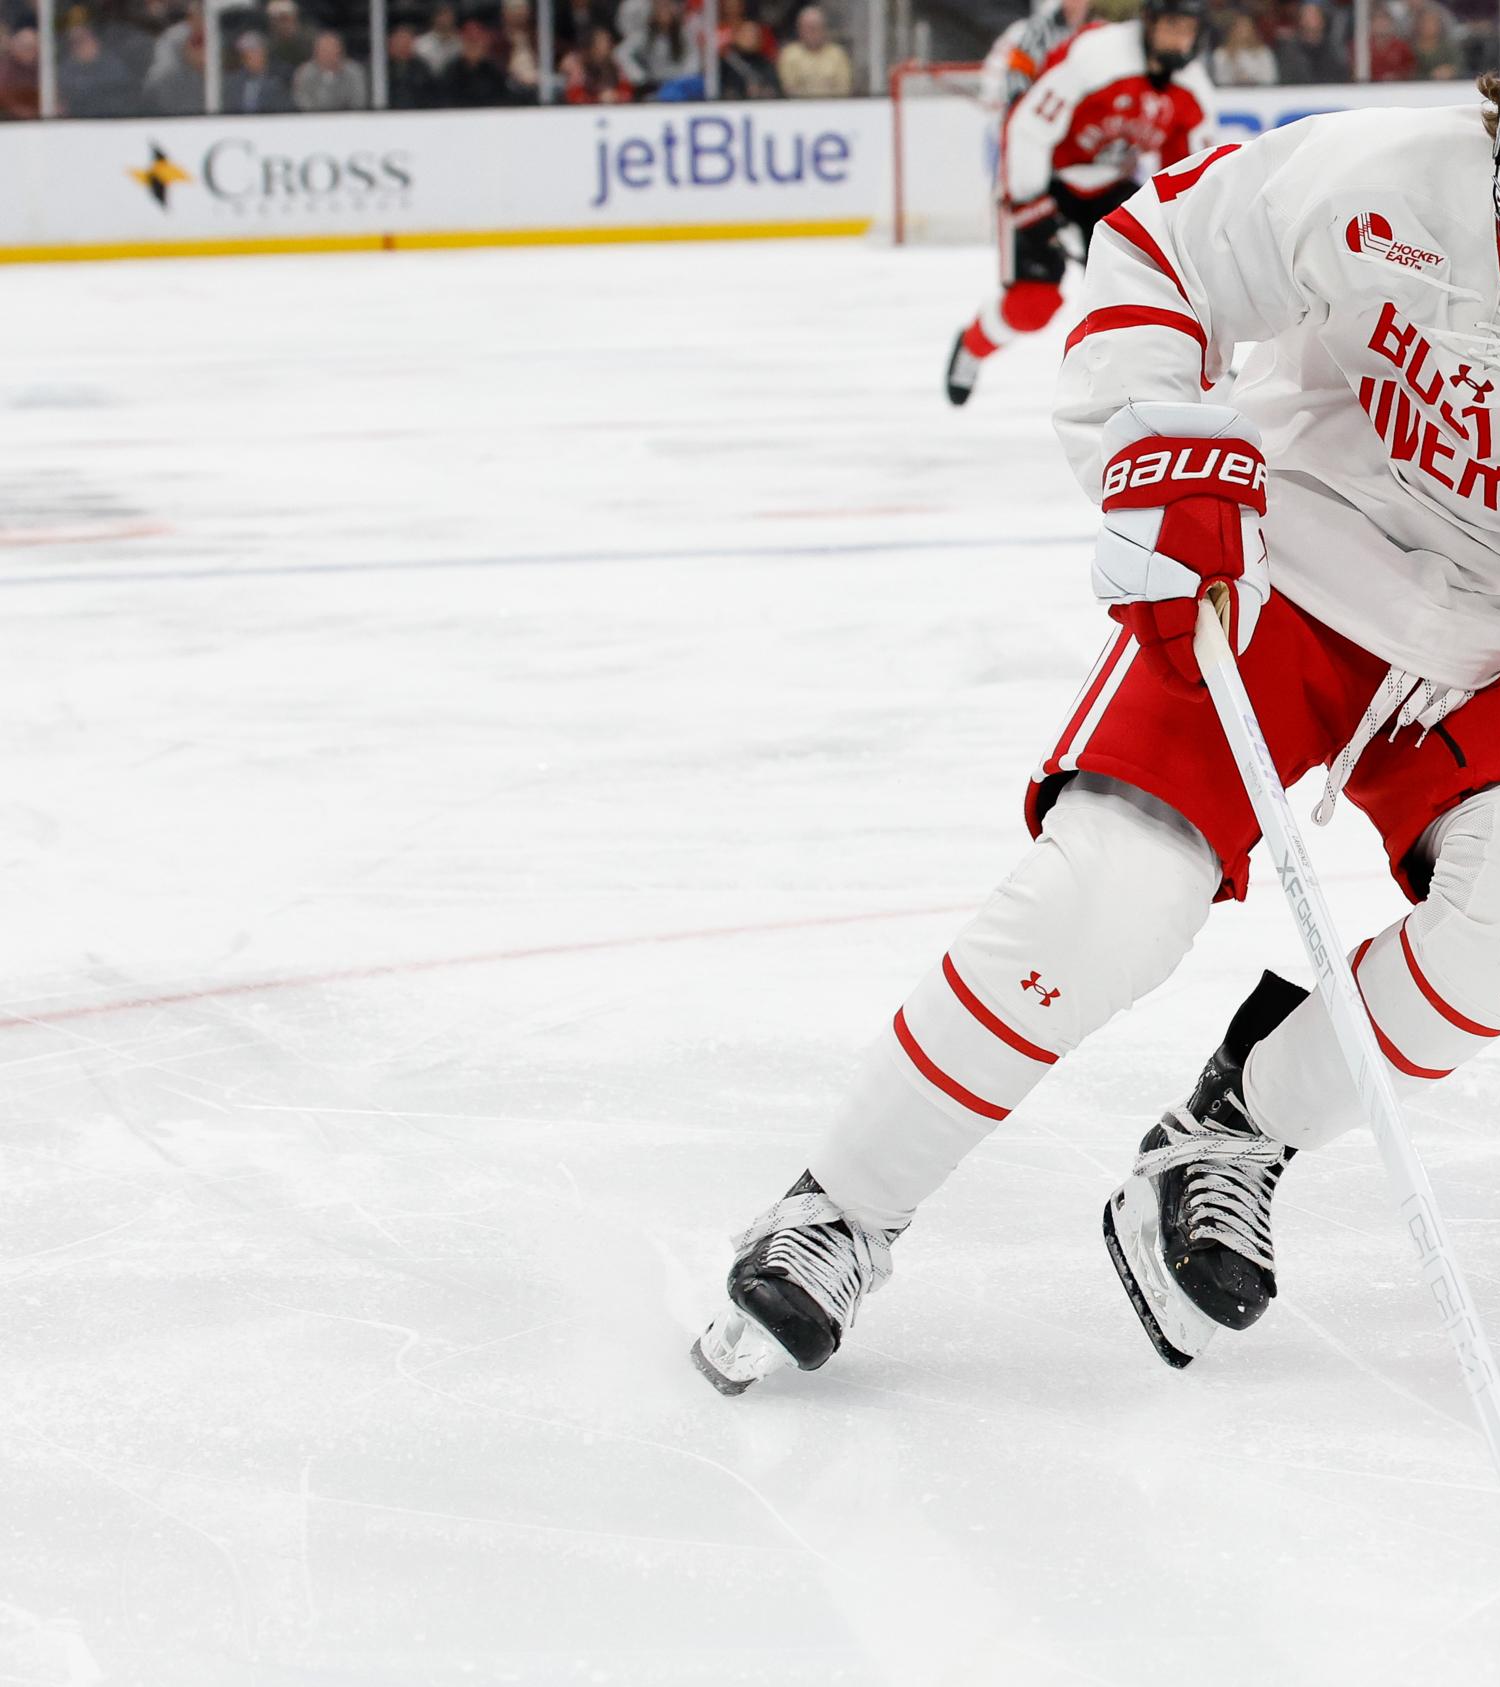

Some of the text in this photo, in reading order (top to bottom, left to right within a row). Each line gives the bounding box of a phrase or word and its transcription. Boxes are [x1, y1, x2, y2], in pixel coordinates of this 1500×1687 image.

[592, 116, 850, 207] jetBlue
[1391, 241, 1444, 265] HOCKEY
[1297, 897, 1334, 980] GHOST
